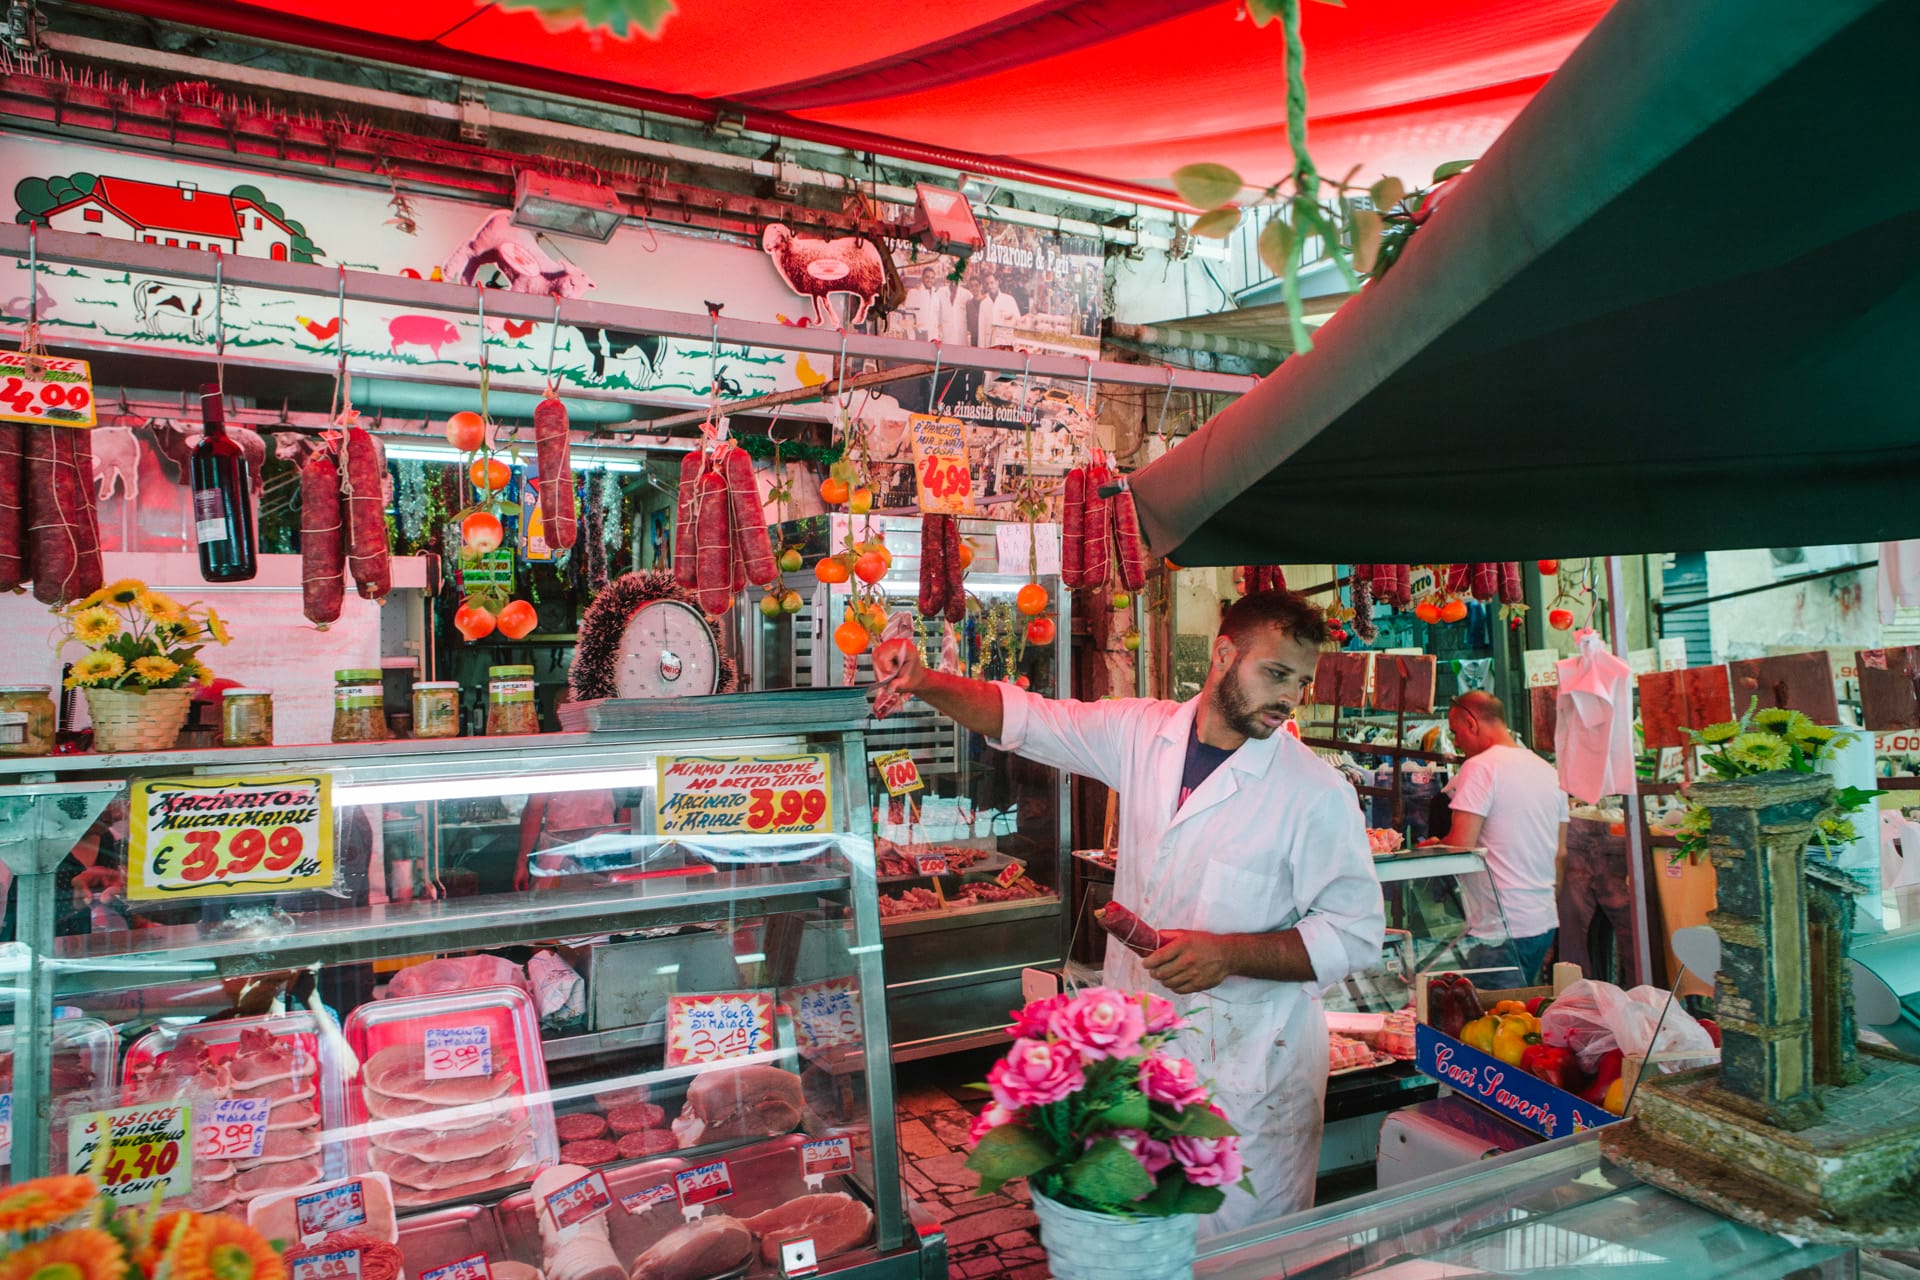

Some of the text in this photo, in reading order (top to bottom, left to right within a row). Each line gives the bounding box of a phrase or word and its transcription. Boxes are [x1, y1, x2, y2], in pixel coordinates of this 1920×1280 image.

[986, 236, 1033, 268] Iavarone
[1035, 252, 1045, 271] &
[665, 760, 726, 777] MIMMO
[719, 775, 770, 789] DETTO
[149, 787, 321, 817] MACINATO DI
[659, 788, 827, 829] MACINATO 3,99
[151, 812, 229, 832] MUCCA
[236, 807, 318, 828] MAIALE
[679, 811, 746, 832] MAIALE
[152, 846, 174, 876] €
[181, 825, 304, 882] 3,99
[687, 1008, 715, 1018] SOLO
[708, 1017, 754, 1029] MAIALE
[691, 1028, 747, 1055] 3,19
[1434, 1042, 1558, 1129] Caci Saverio
[216, 1110, 267, 1123] MAIALE
[197, 1123, 254, 1155] 3,99
